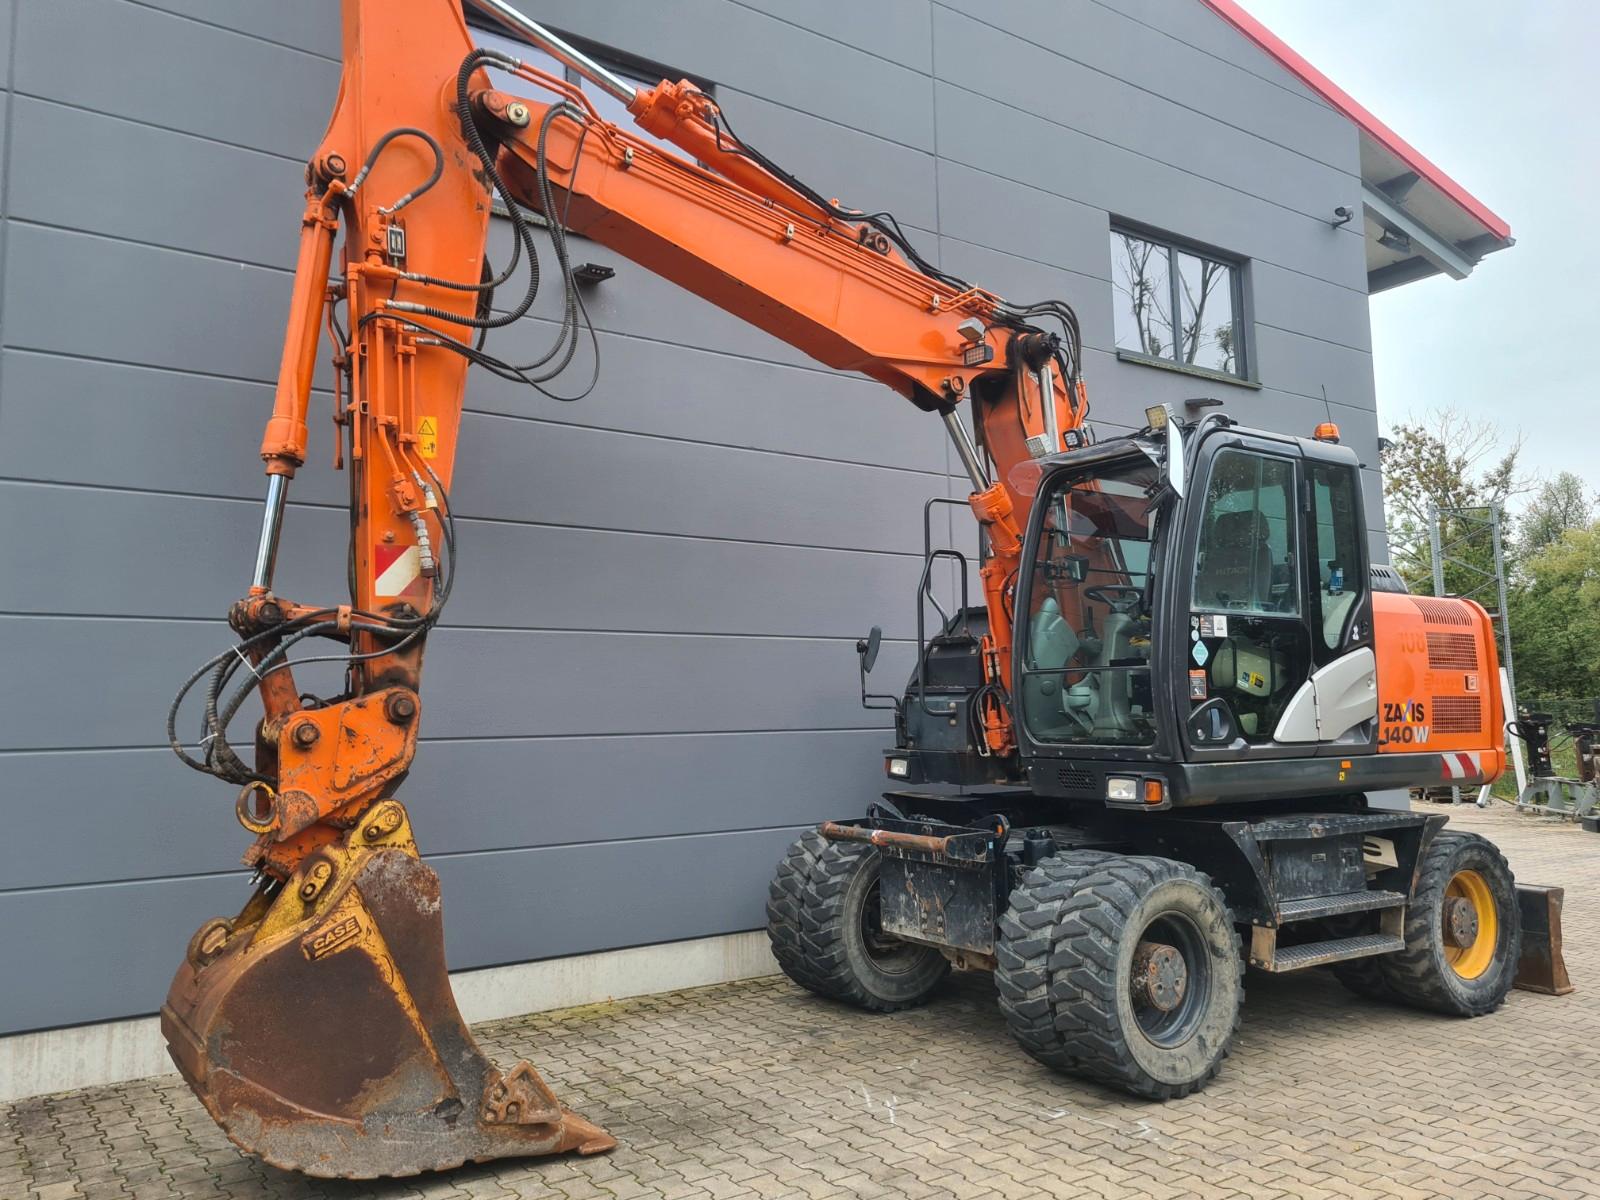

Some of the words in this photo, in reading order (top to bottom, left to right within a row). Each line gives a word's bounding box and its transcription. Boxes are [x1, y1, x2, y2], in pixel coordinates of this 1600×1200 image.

[1384, 699, 1425, 724] ZAXIS
[1384, 726, 1430, 744] 140W
[313, 918, 356, 950] CASE
